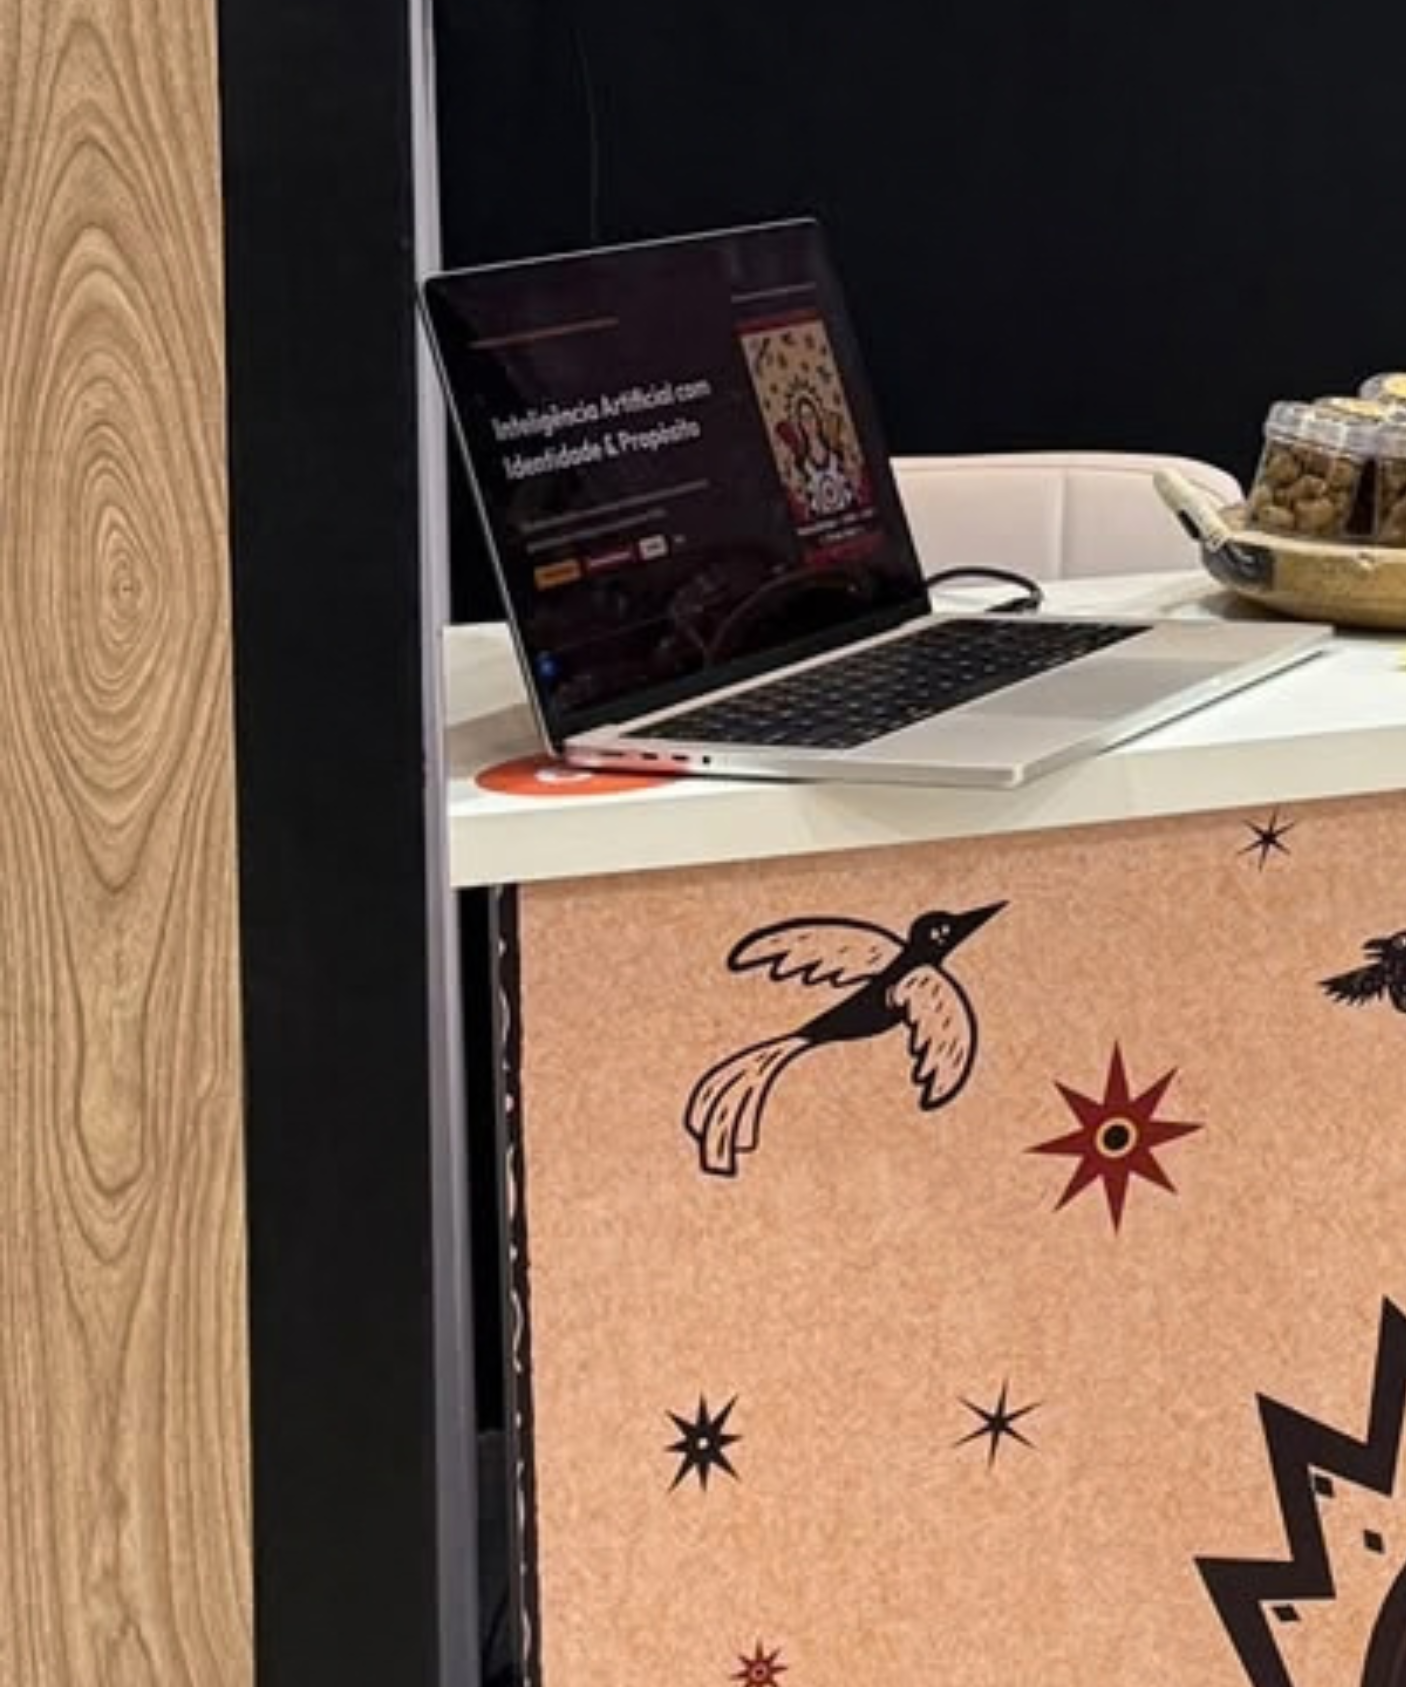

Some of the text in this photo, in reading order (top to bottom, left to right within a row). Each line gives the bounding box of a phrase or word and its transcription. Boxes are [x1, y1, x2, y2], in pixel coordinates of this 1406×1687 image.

[491, 379, 711, 442] Inteligência Artificial com
[503, 437, 602, 480] Identidade
[618, 417, 701, 452] Propósito
